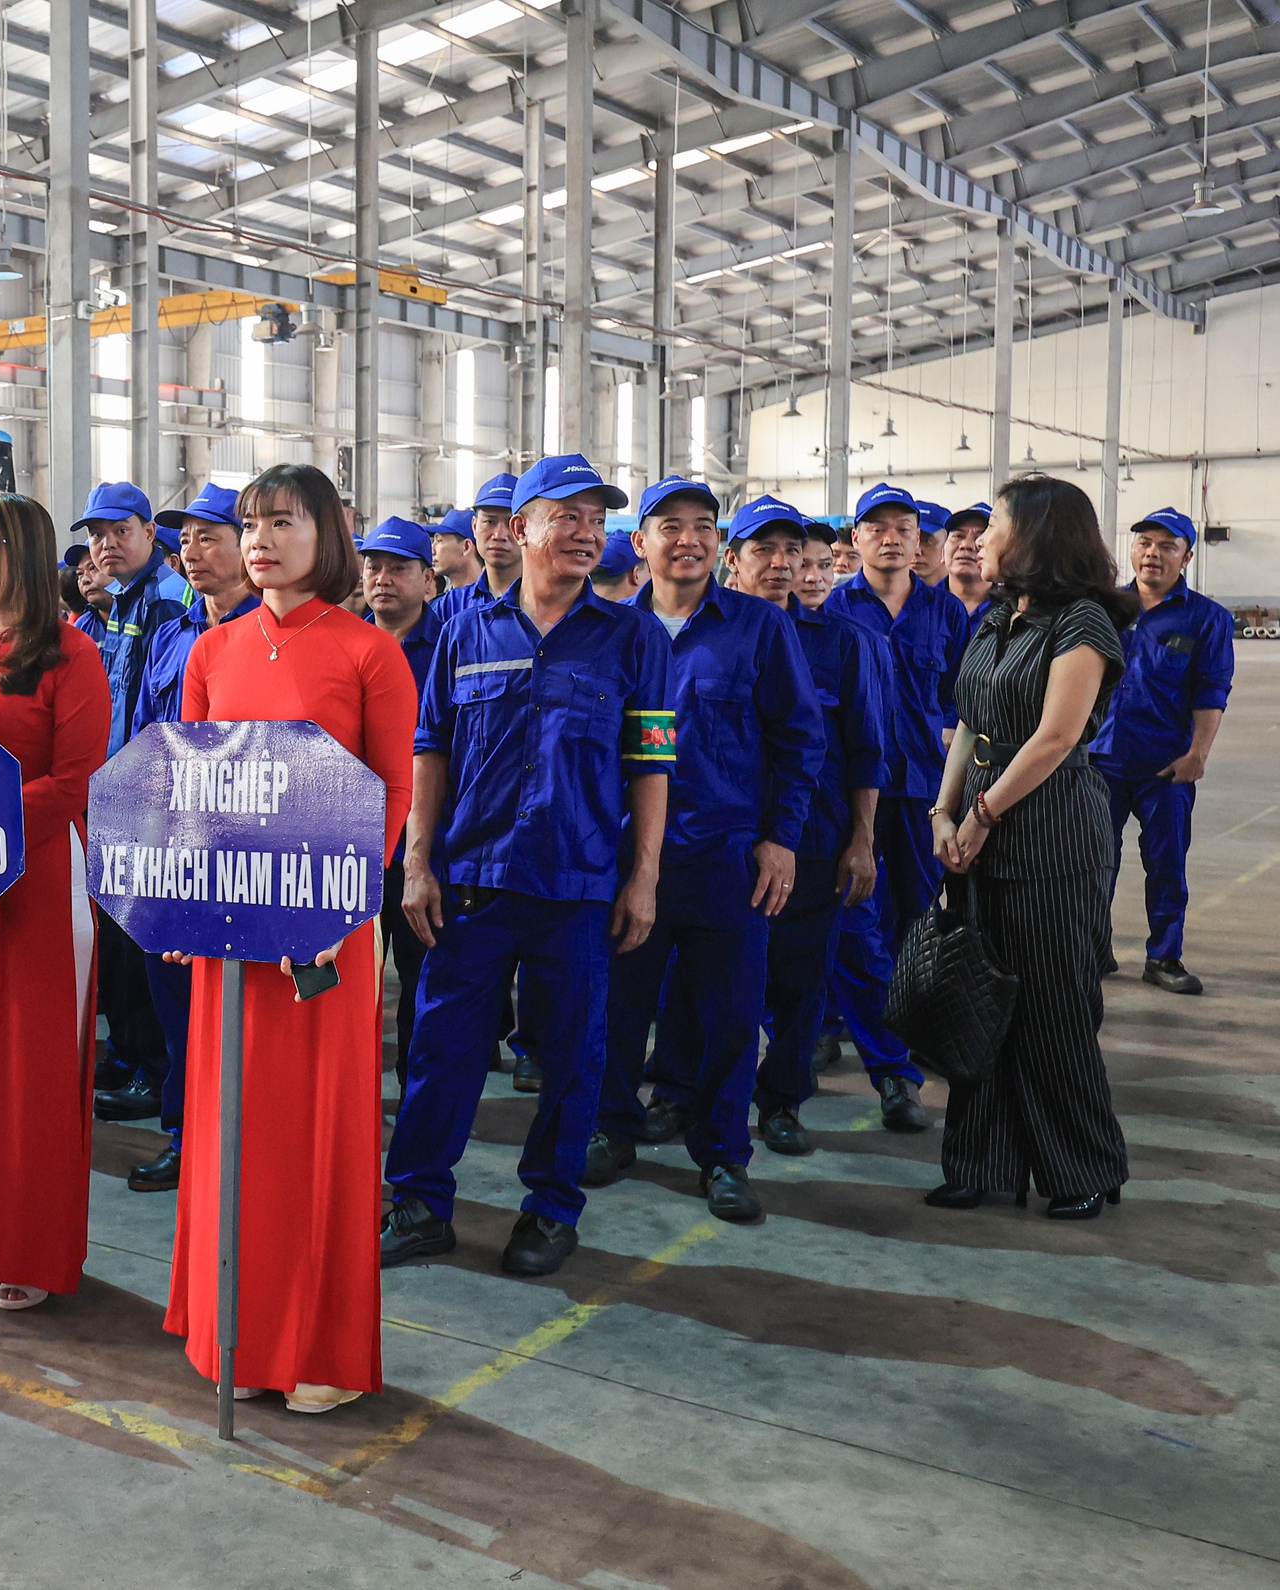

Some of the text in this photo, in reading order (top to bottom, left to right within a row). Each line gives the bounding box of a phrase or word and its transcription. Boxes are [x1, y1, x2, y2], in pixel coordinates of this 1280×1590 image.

[169, 747, 289, 827] XÍ NGHIỆP
[99, 836, 368, 924] XE KHÁCH NAM HÀ NỘI
